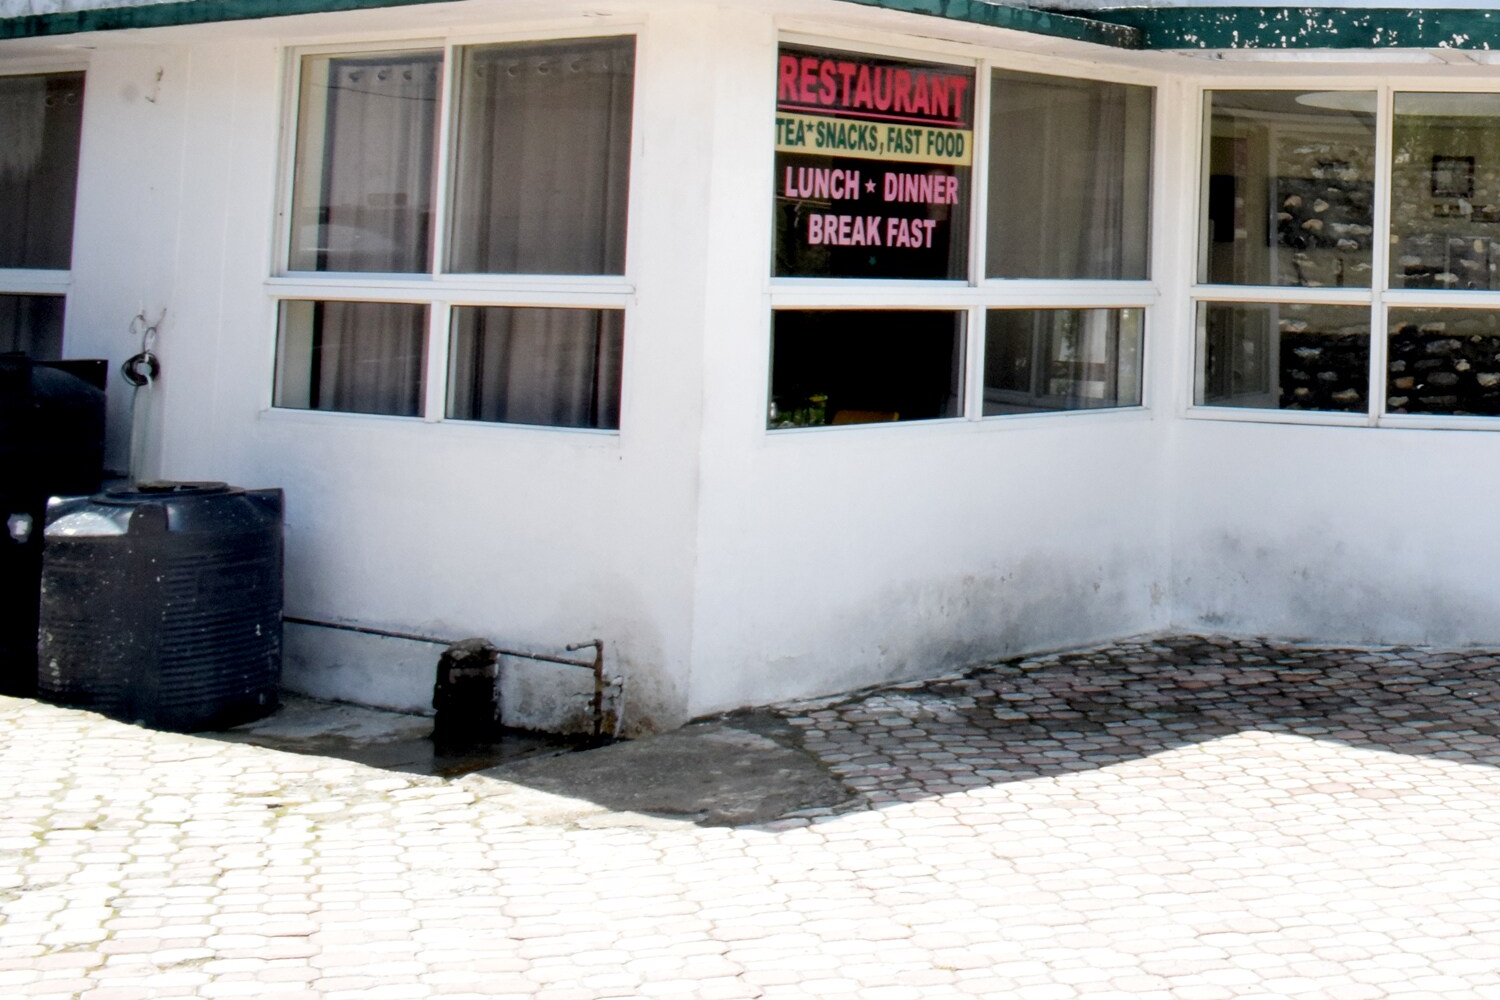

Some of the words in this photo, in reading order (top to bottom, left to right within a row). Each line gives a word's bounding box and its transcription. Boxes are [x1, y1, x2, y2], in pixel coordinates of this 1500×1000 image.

[778, 55, 968, 118] RESTAURANT
[886, 126, 923, 155] FAST
[926, 130, 965, 158] FOOD
[785, 166, 860, 200] LUNCH
[884, 172, 959, 205] DINNER
[808, 213, 882, 246] BREAK
[886, 217, 936, 249] FAST
